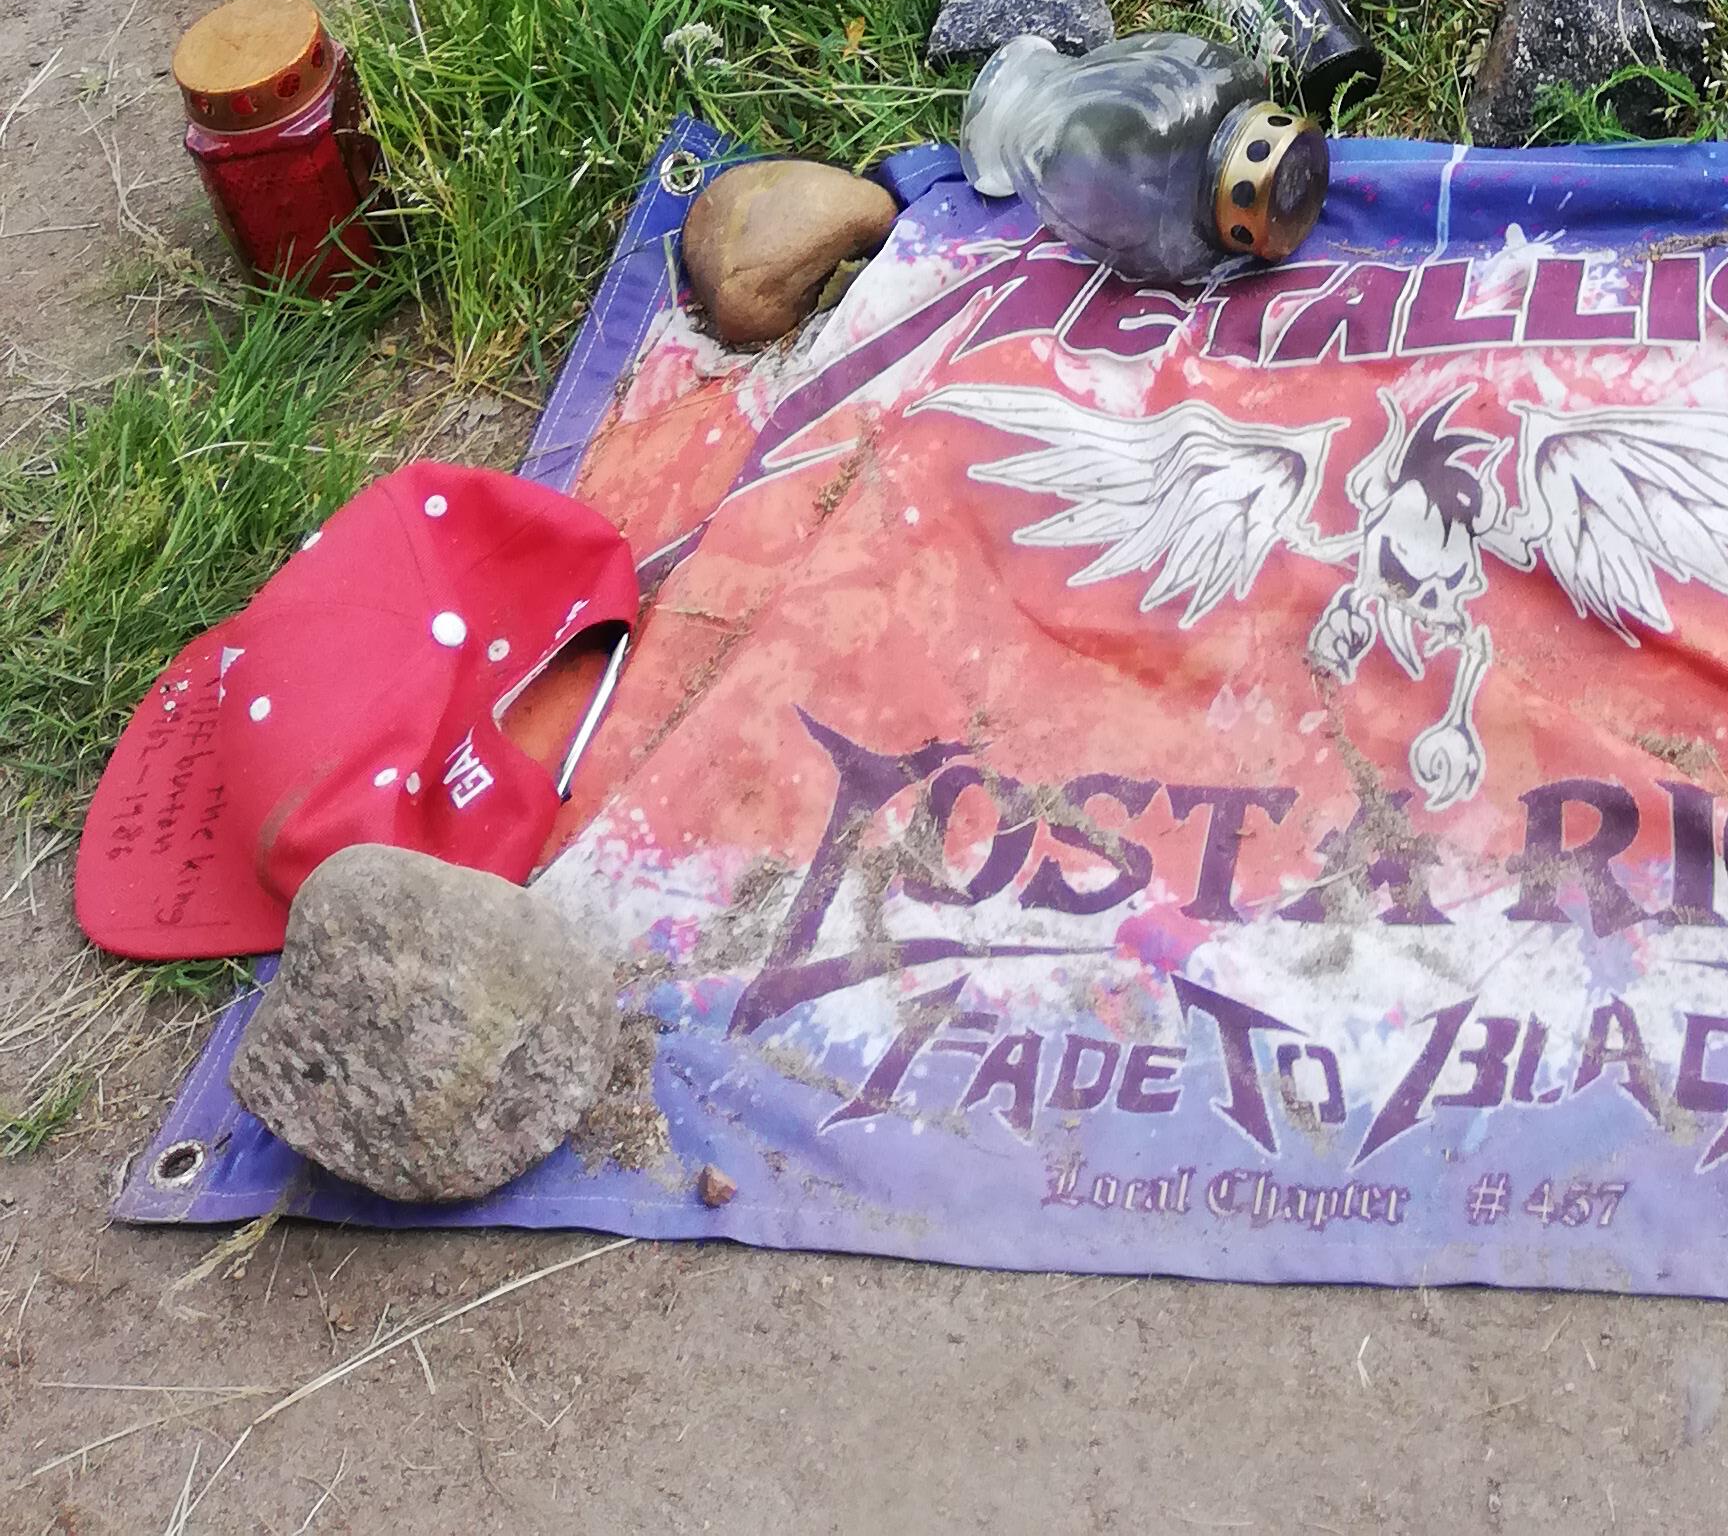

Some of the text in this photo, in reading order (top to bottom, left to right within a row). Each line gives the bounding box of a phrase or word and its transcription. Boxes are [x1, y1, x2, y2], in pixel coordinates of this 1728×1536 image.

[819, 973, 1188, 1133] FADE
[1169, 972, 1344, 1161] TO
[1040, 1162, 1197, 1215] Local
[1205, 1165, 1410, 1232] Chapter
[1521, 1178, 1632, 1230] 457
